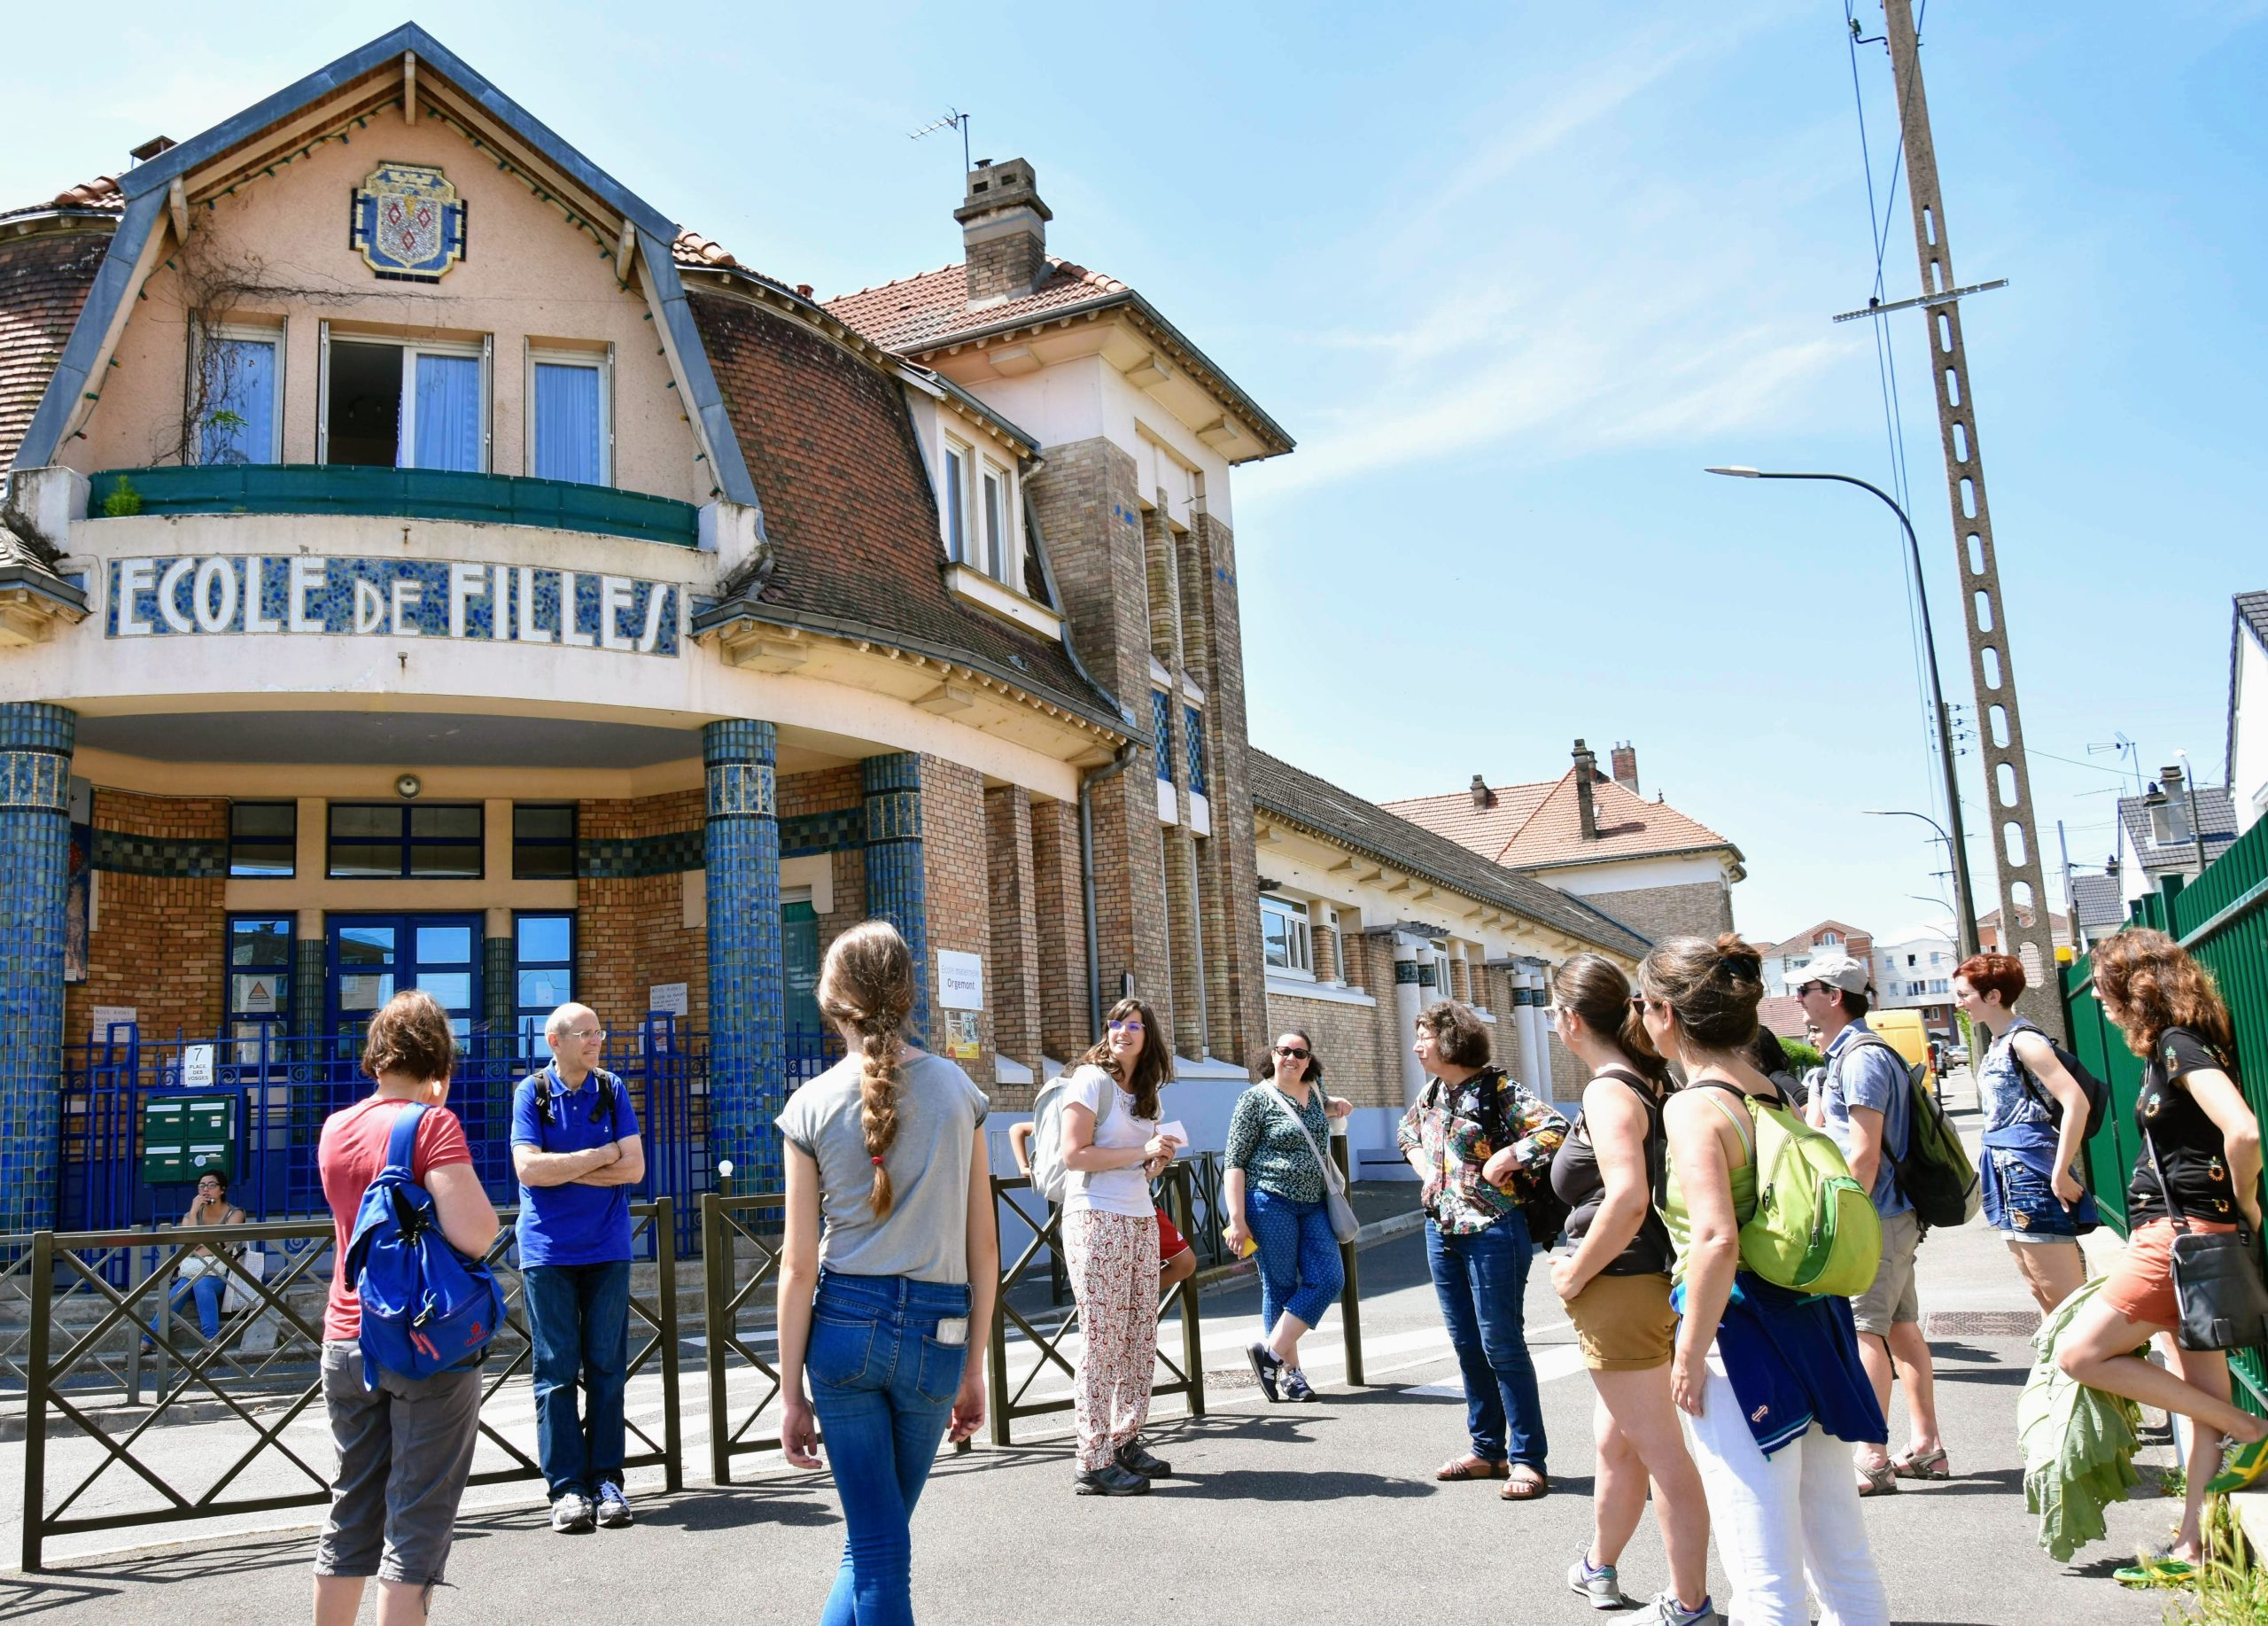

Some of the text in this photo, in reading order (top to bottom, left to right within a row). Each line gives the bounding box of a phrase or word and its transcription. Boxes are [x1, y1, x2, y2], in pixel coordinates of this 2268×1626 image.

[118, 556, 667, 652] ECOLE DE FILLES
[948, 978, 975, 990] Orgemont
[194, 1047, 203, 1062] 7
